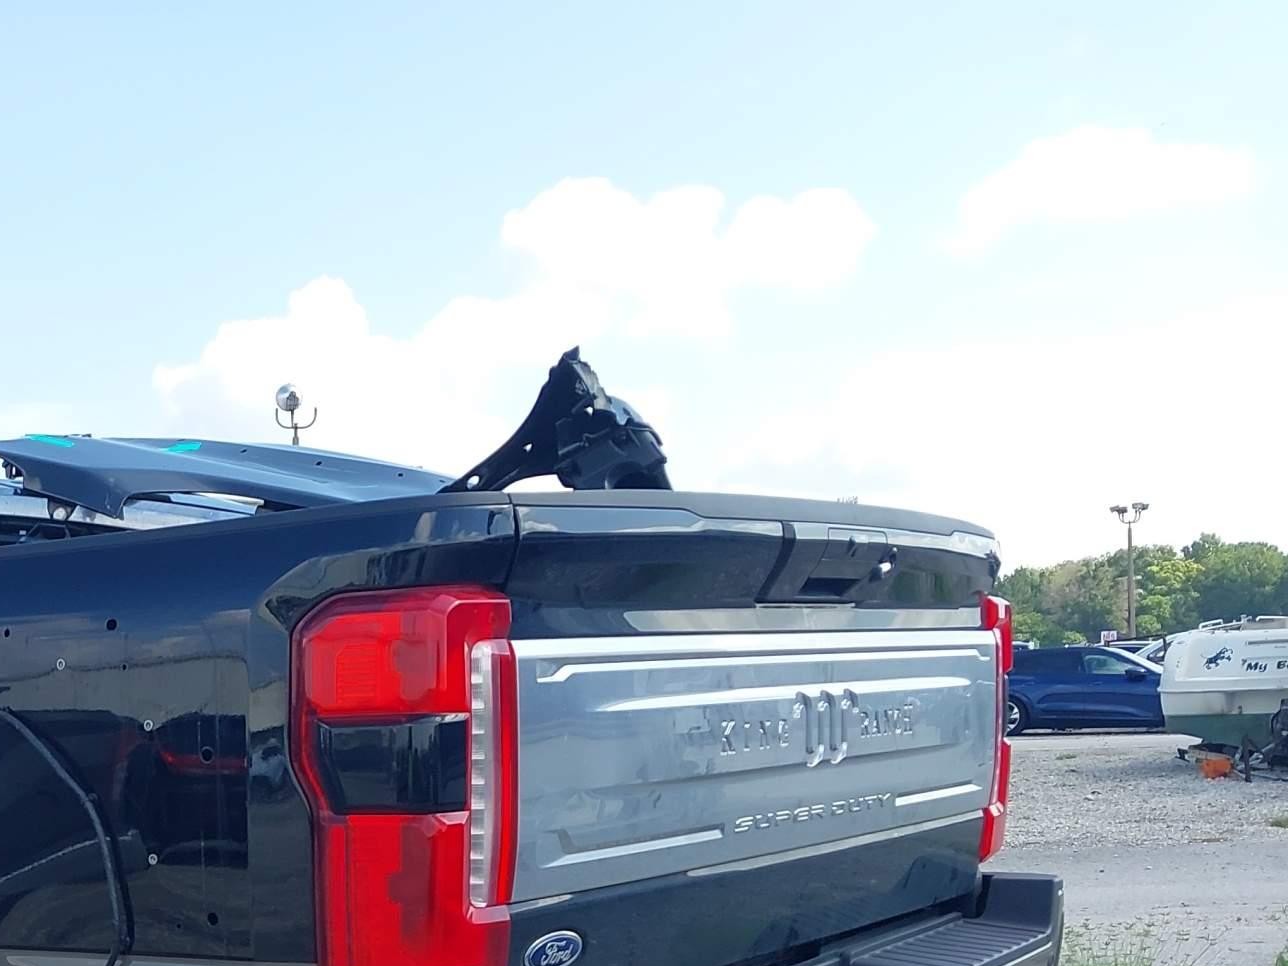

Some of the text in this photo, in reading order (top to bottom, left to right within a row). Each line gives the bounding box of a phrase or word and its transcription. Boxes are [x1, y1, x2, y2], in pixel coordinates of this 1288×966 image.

[1277, 660, 1288, 670] B
[720, 703, 913, 755] KING RANCH
[734, 793, 891, 833] SUPER DUTY
[541, 940, 574, 966] Ford
